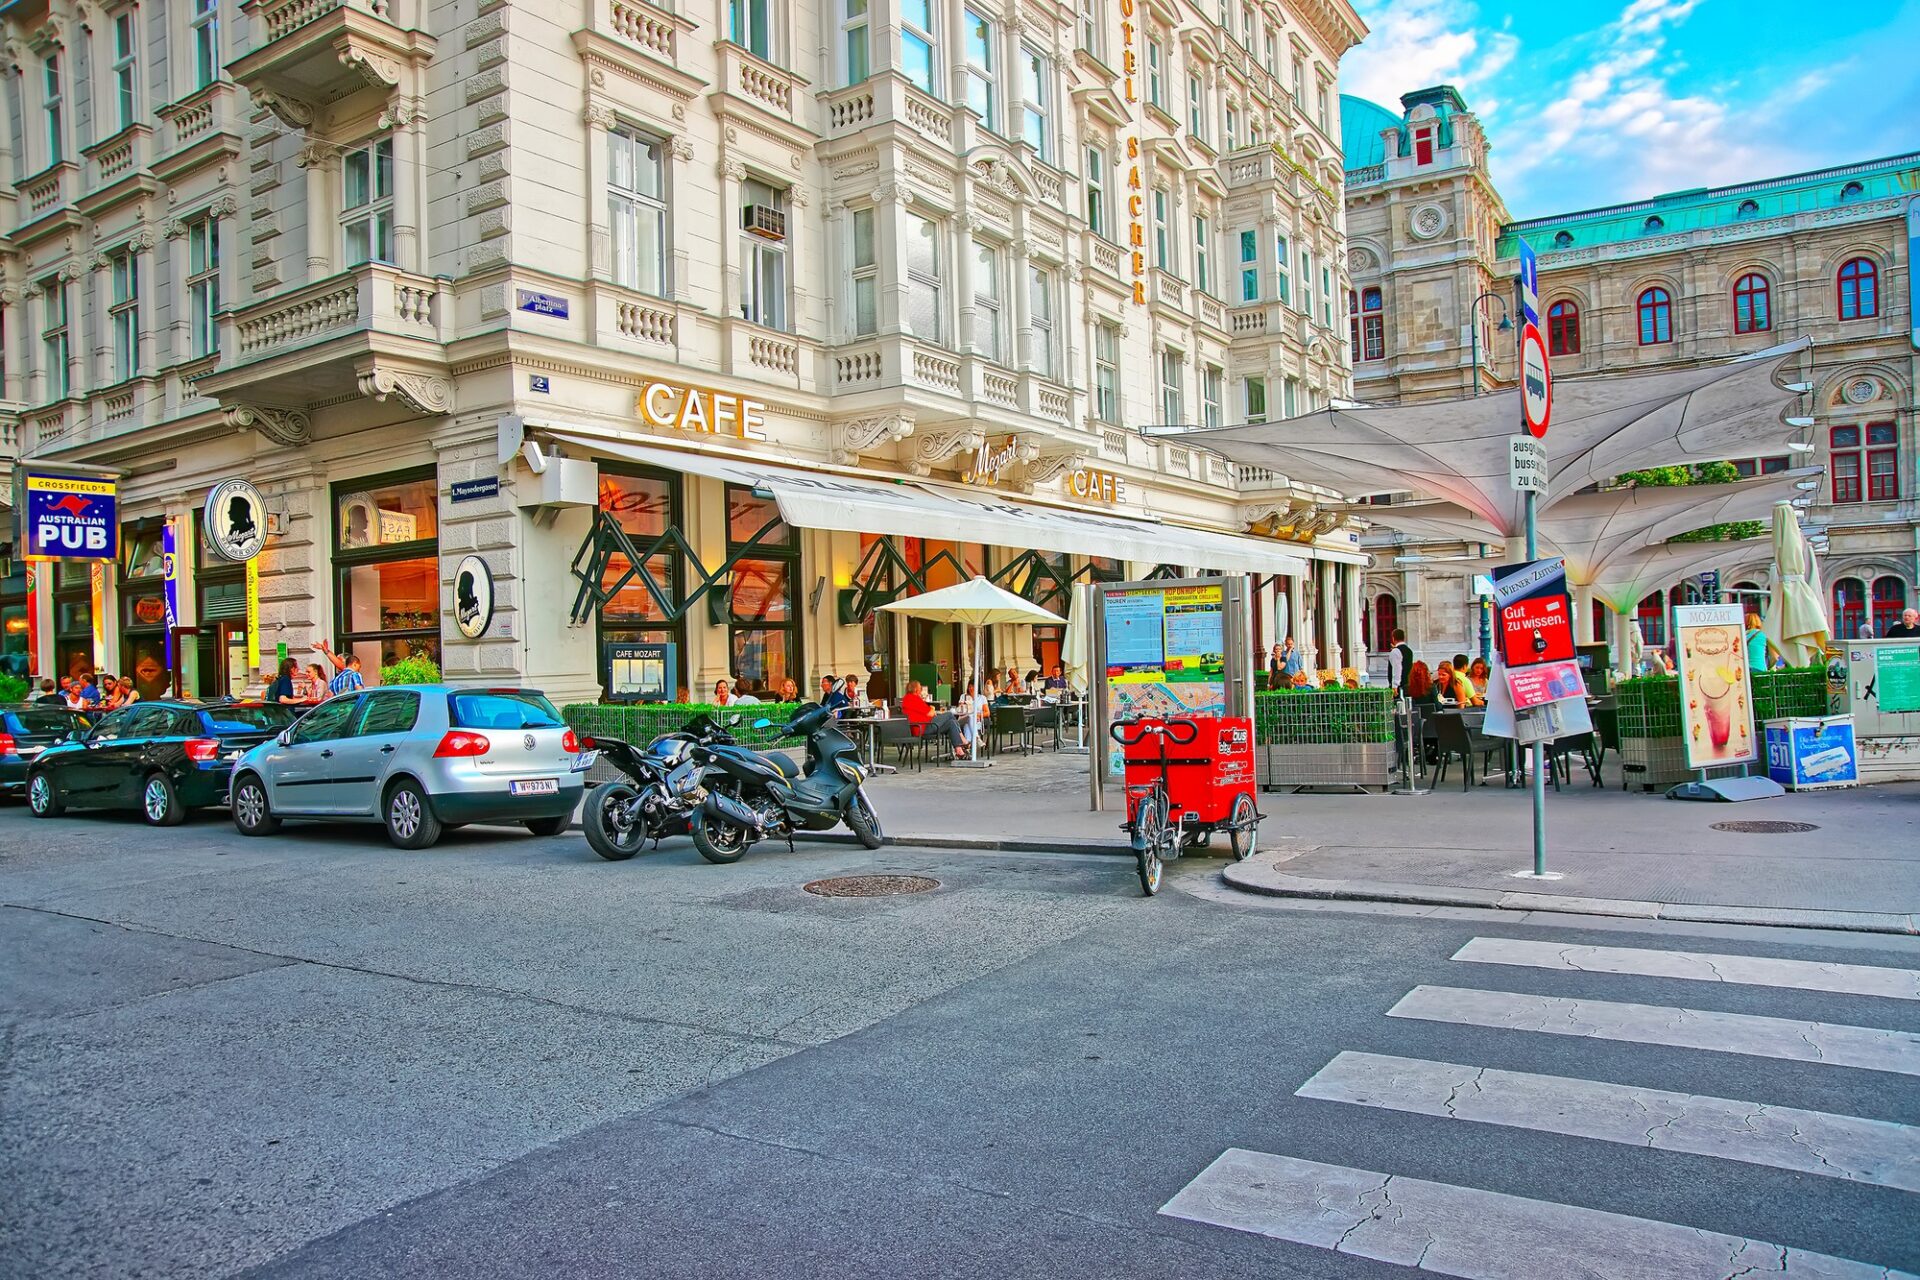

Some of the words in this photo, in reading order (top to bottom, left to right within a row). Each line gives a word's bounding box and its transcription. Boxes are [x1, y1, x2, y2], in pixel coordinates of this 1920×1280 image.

[1127, 135, 1146, 305] SACHER
[536, 377, 544, 388] 2
[642, 383, 767, 441] CAFE
[966, 435, 1018, 484] Mozart
[38, 480, 106, 492] CROSSFIELD'S
[1071, 469, 1127, 504] CAFE
[38, 514, 106, 526] AUSTRALIAN
[38, 523, 107, 550] PUB
[1499, 578, 1531, 598] WIENER
[1531, 561, 1562, 583] ZEITUNG
[1504, 606, 1526, 620] Gut
[1690, 611, 1731, 622] MOZART
[1507, 620, 1521, 632] zu
[1523, 614, 1566, 630] wissen.
[615, 650, 632, 658] CAFE
[634, 650, 661, 658] MOZART
